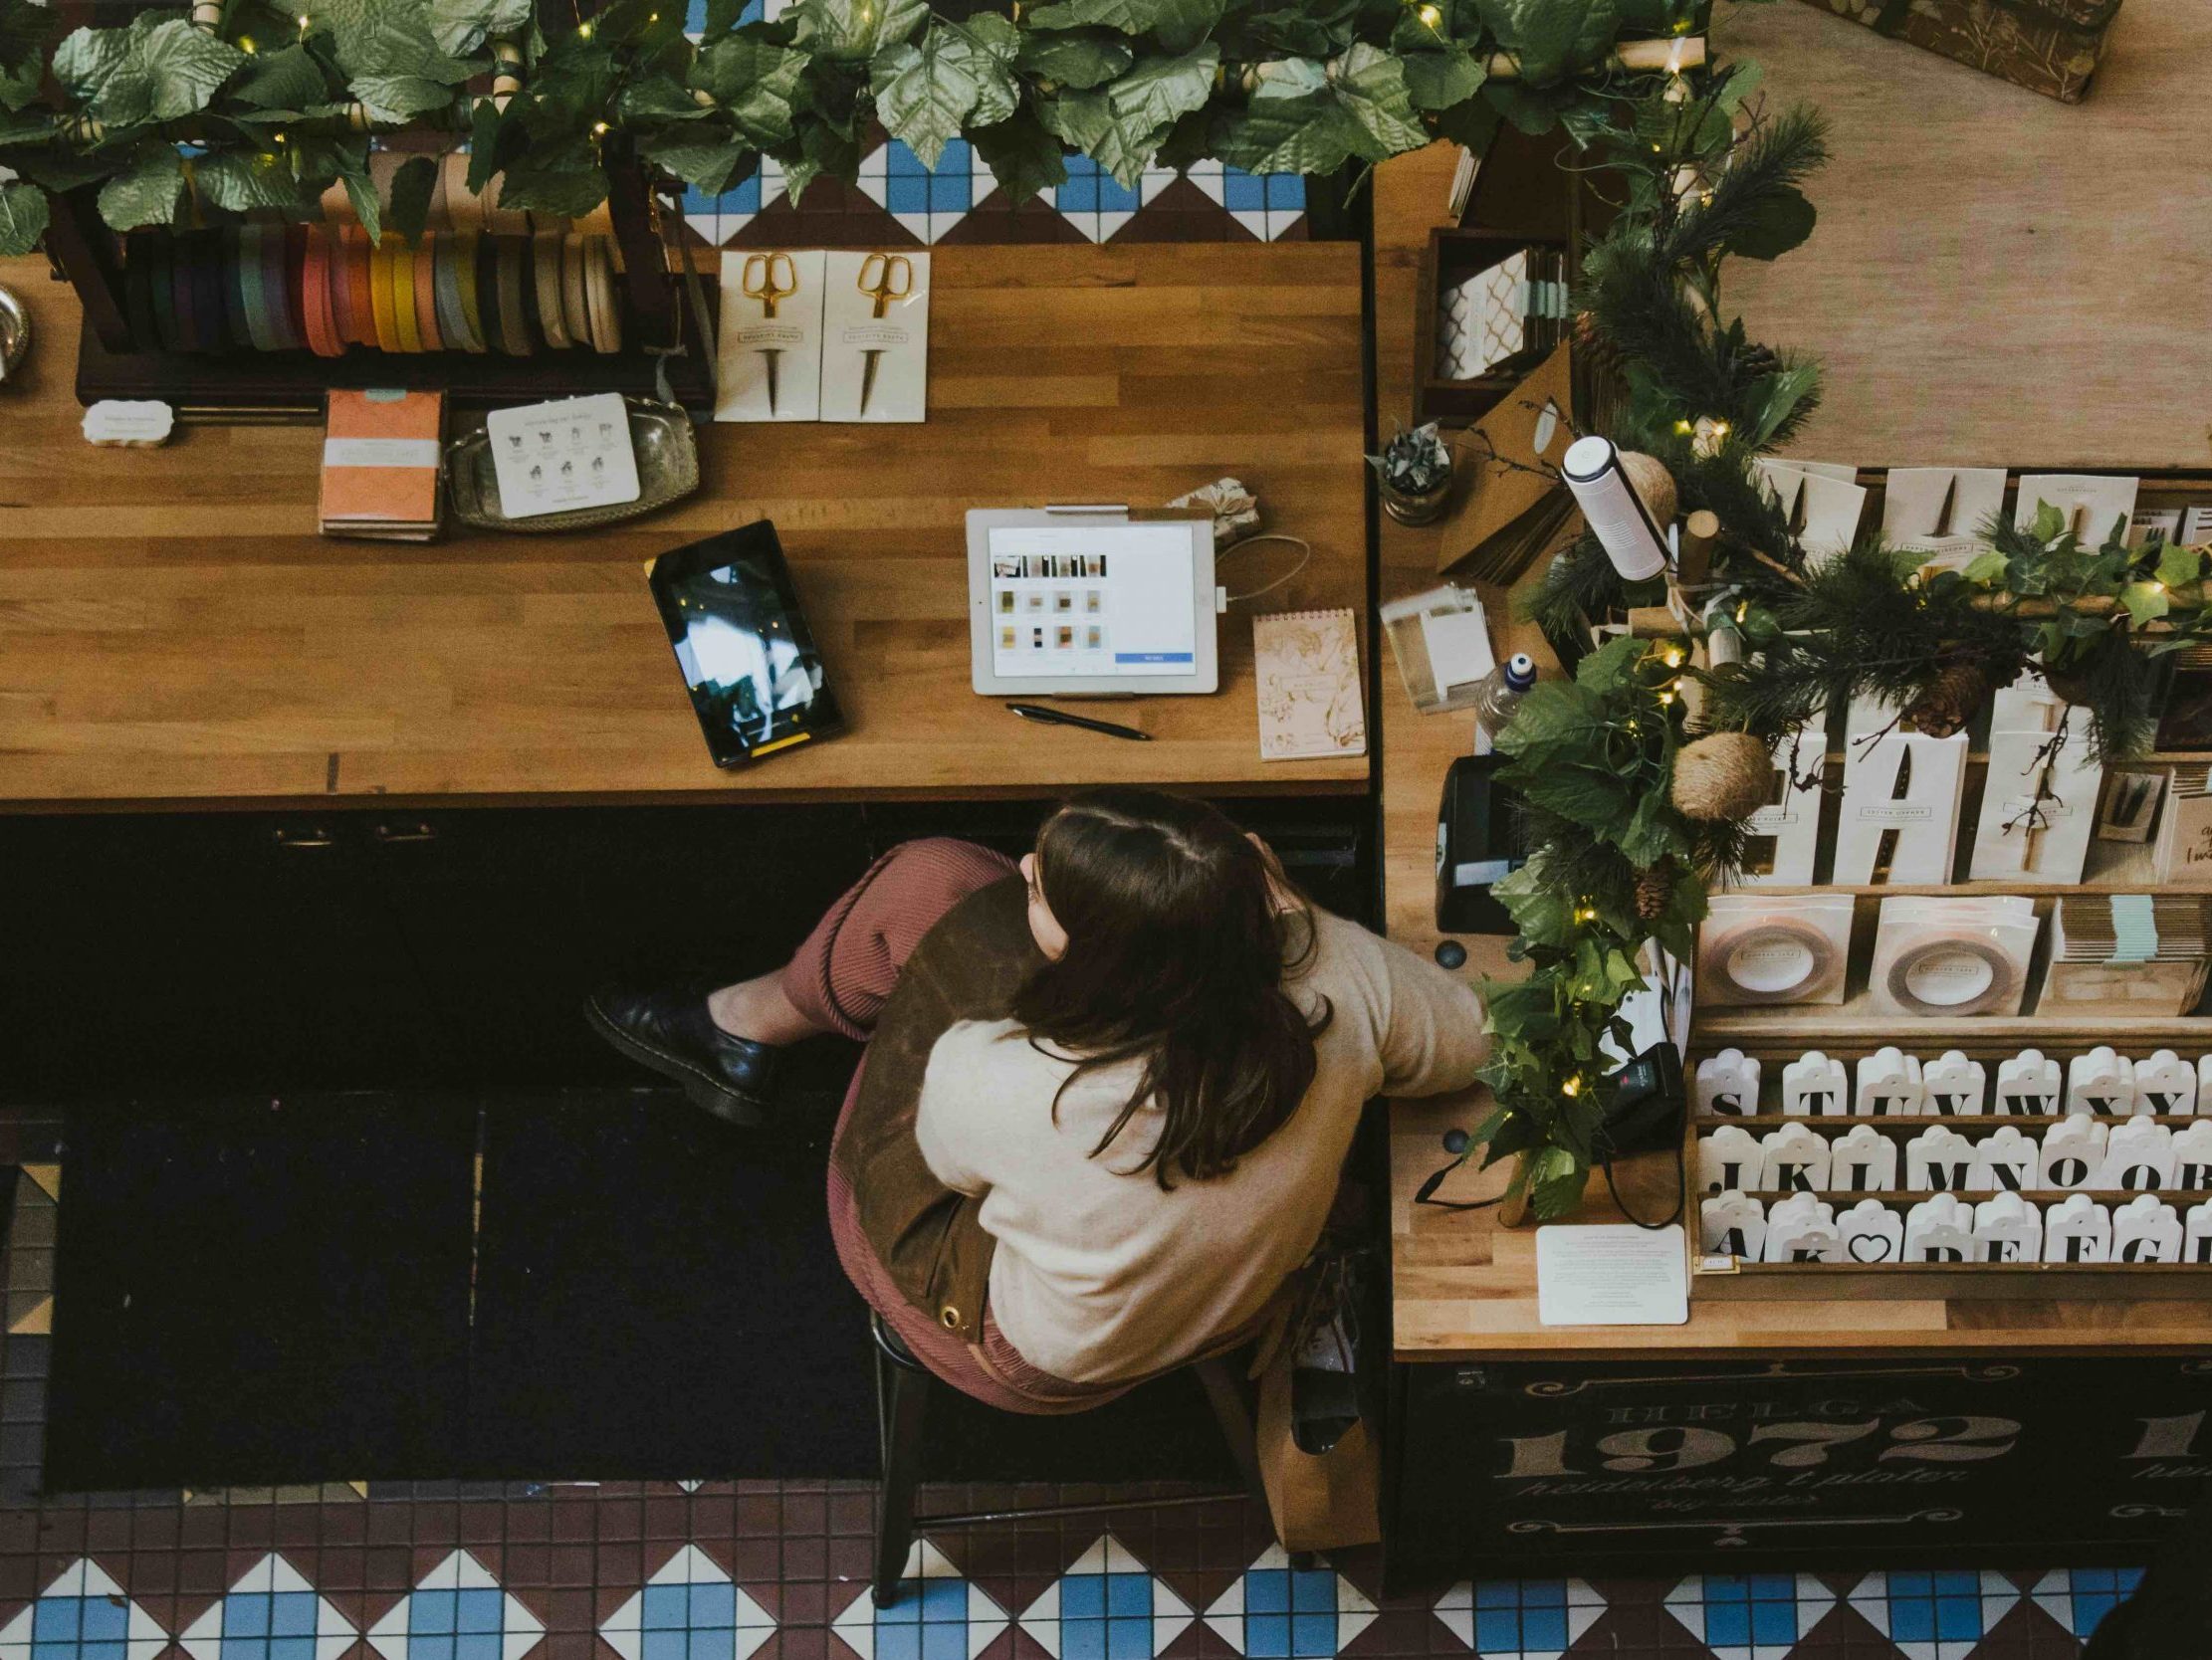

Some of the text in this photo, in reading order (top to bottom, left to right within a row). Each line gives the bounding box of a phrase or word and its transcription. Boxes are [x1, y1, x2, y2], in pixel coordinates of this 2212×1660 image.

[1711, 1094, 1742, 1116] S
[1799, 1092, 1835, 1116] T
[1928, 1094, 1971, 1116] V
[2004, 1096, 2057, 1116] W
[2145, 1093, 2185, 1116] Y
[1778, 1163, 1815, 1191] K
[1850, 1163, 1881, 1191] L
[1924, 1162, 1970, 1191] M
[1991, 1163, 2028, 1191] N
[2049, 1157, 2089, 1187] O
[1711, 1227, 1749, 1258] A
[2122, 1237, 2160, 1262] G
[1608, 1397, 1930, 1423] HELGA
[1493, 1416, 2022, 1479] 1972
